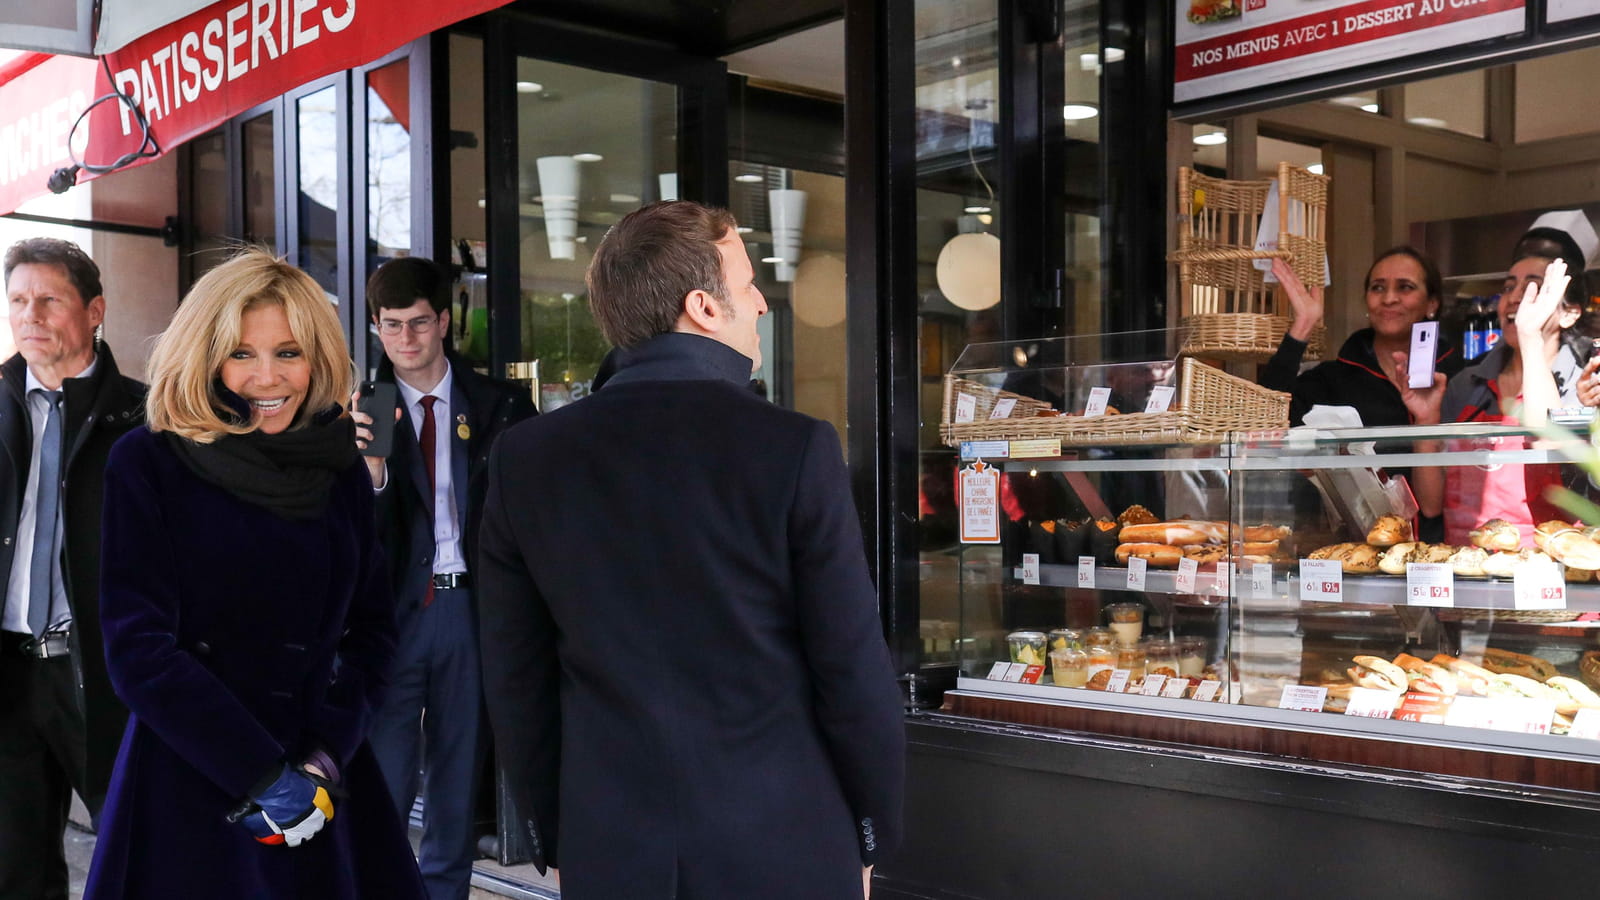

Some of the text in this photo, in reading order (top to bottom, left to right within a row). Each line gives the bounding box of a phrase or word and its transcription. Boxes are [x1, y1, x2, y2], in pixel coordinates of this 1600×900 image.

[1192, 0, 1444, 67] NOS MENUS AVEC 1 DESSERT AU
